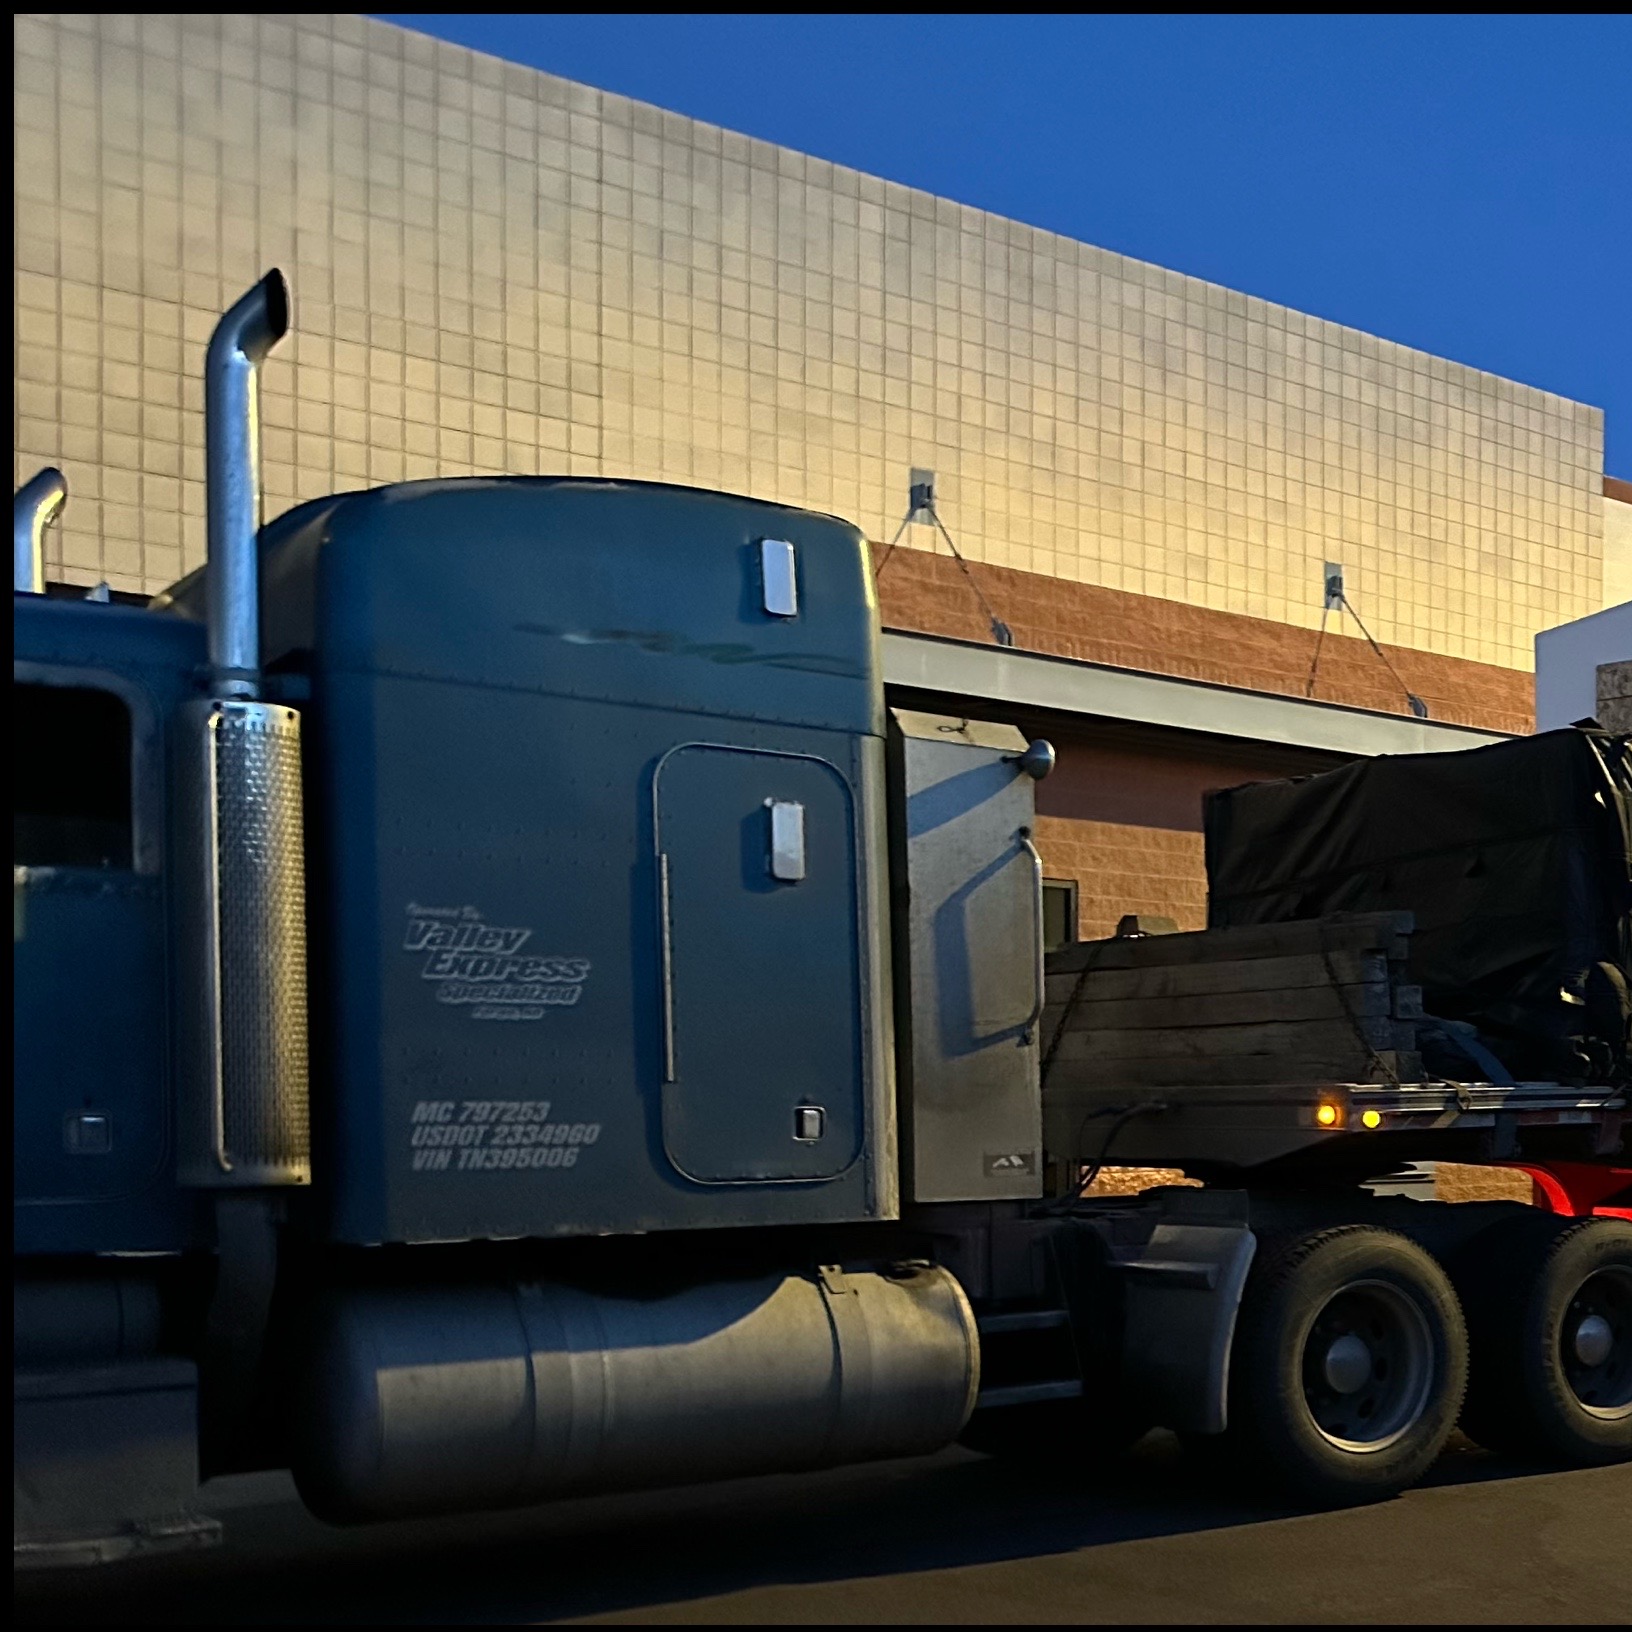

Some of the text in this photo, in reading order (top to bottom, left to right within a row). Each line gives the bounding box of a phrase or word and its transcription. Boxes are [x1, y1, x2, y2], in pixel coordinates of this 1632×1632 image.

[403, 919, 532, 955] Valley
[422, 950, 591, 982] Express
[412, 1101, 551, 1123] MC 797253
[412, 1124, 490, 1146] USDOT
